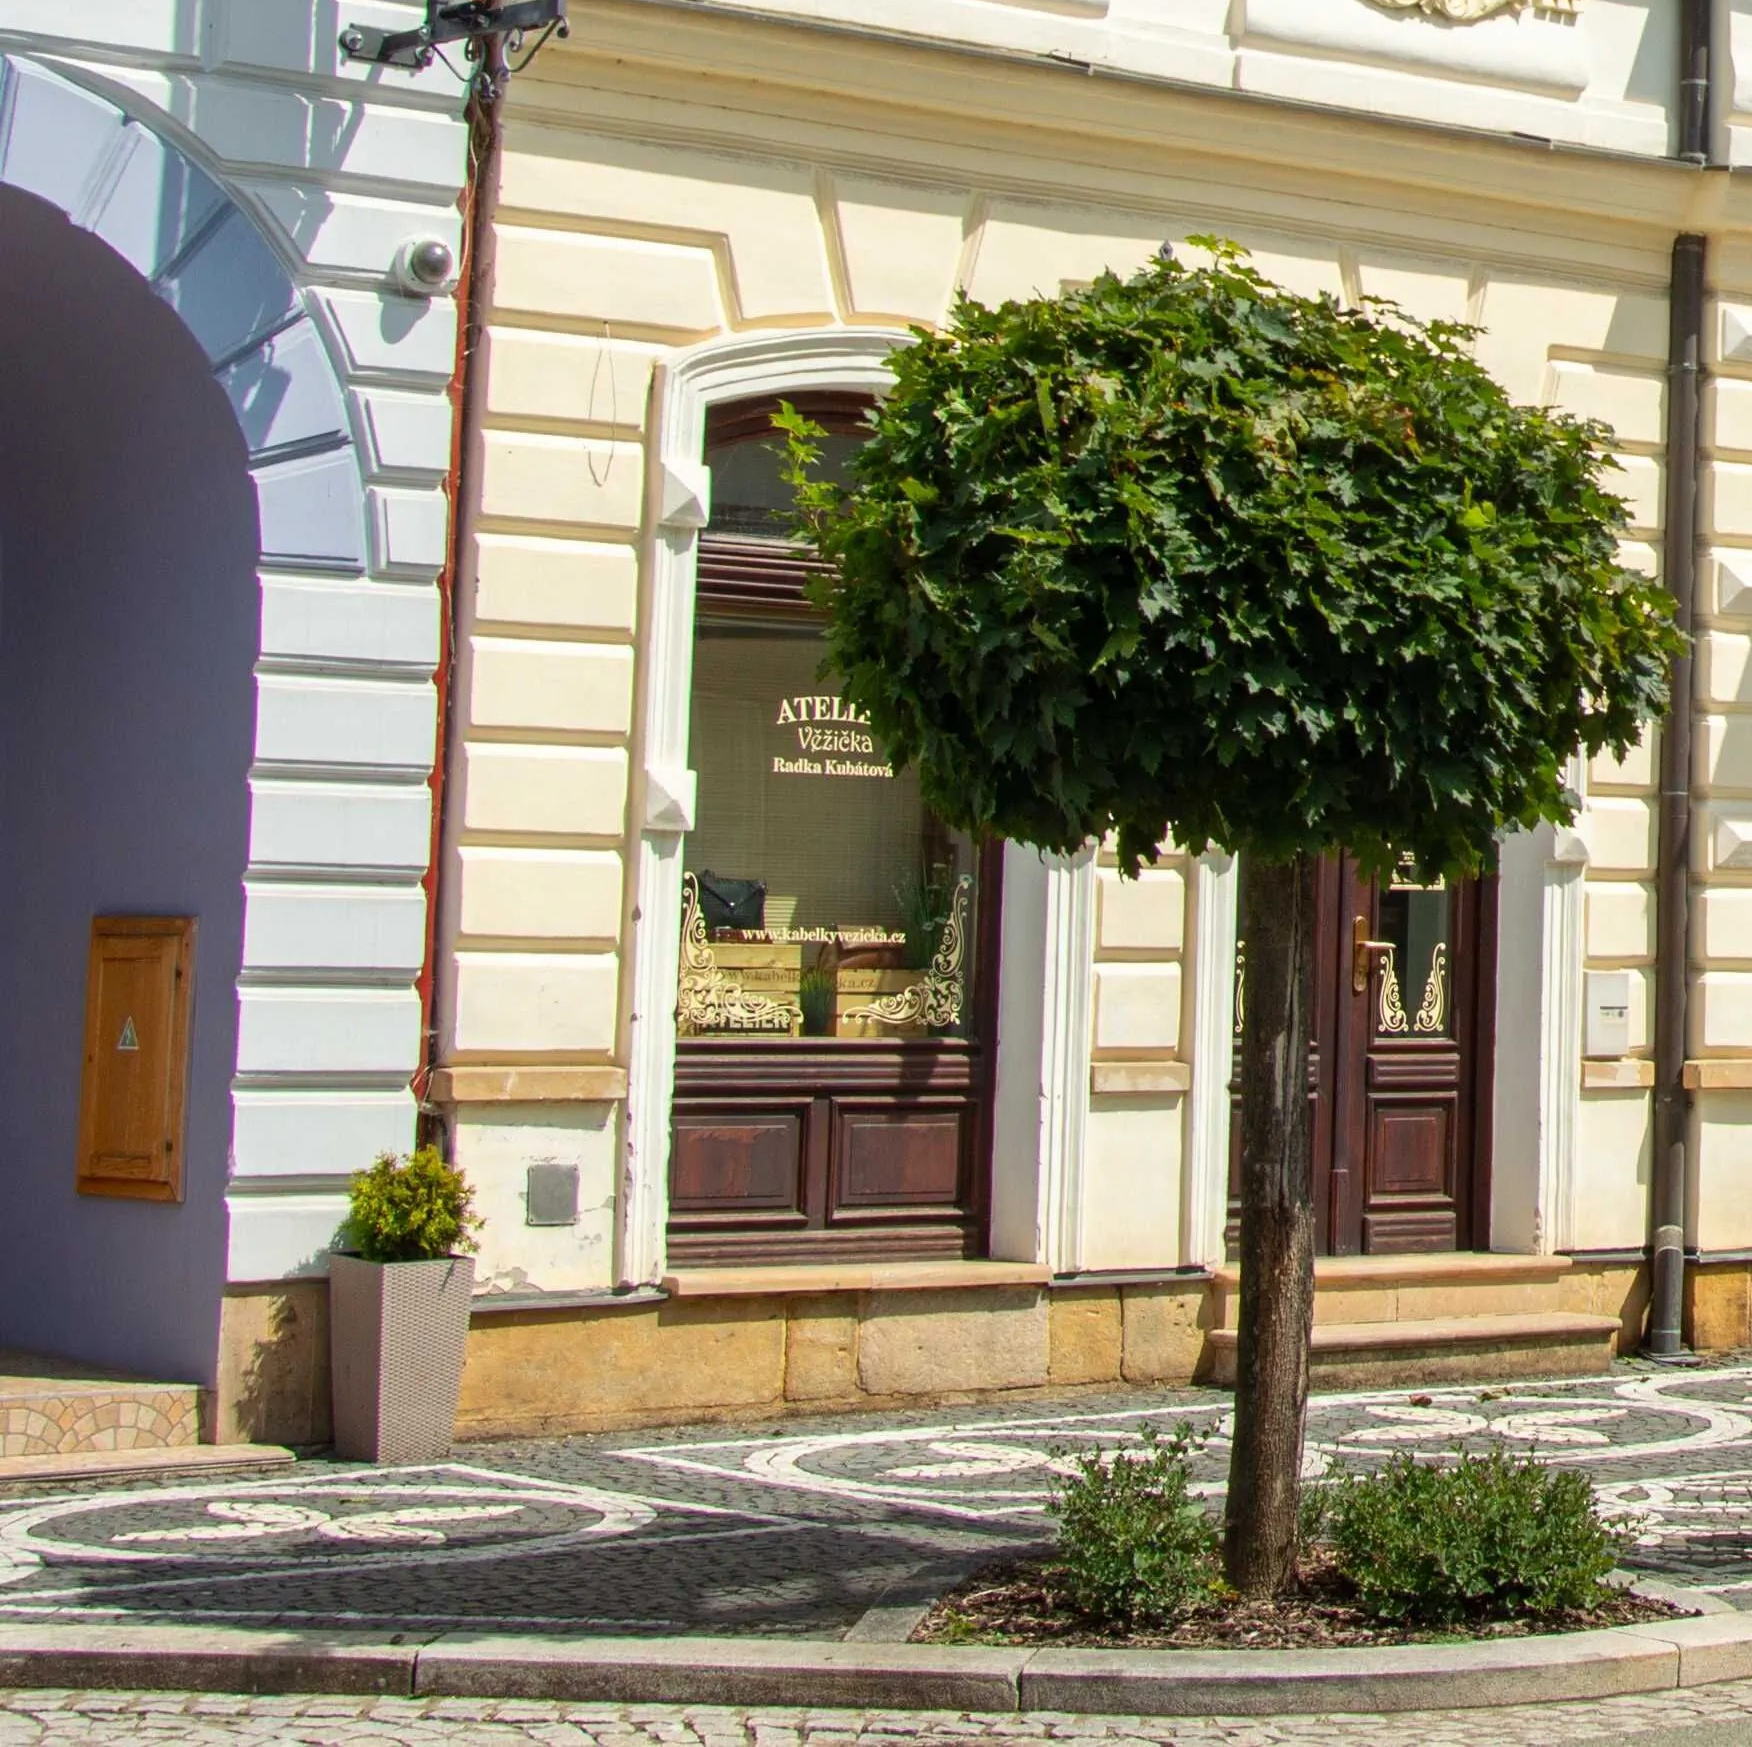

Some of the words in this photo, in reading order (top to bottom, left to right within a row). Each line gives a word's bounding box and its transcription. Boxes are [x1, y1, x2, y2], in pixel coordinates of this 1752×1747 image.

[798, 726, 873, 753] Věžička
[772, 757, 822, 774] Radka
[824, 759, 893, 778] Kubátová
[742, 927, 906, 945] www.kabelkyvezicka.cz
